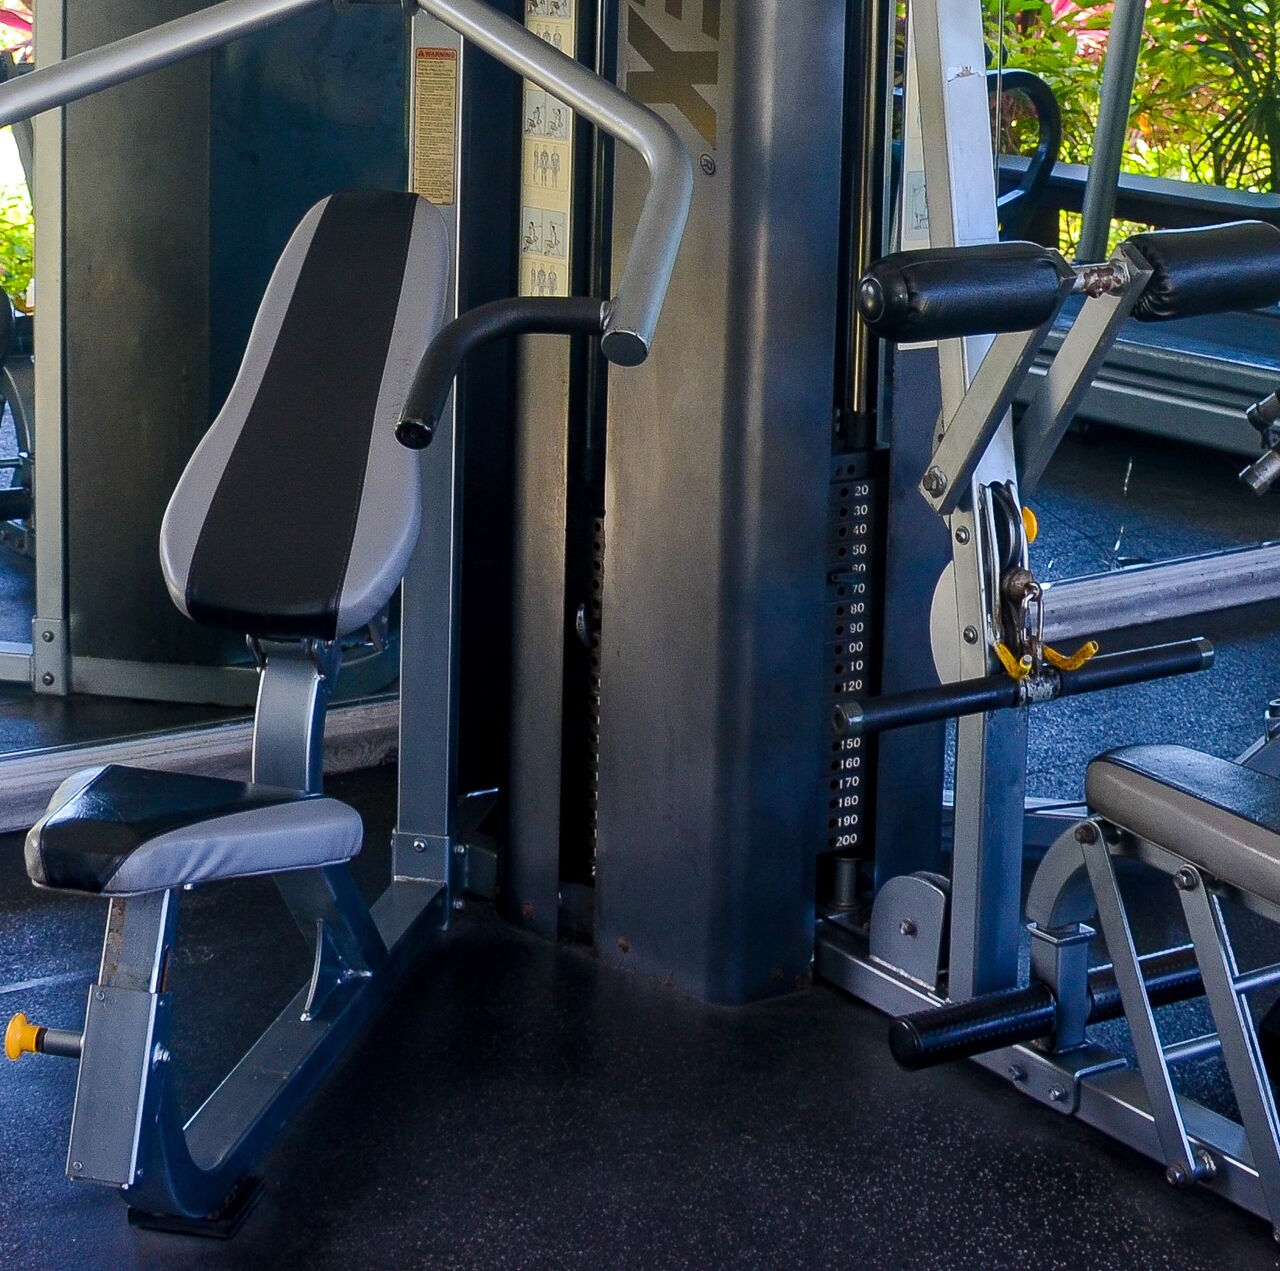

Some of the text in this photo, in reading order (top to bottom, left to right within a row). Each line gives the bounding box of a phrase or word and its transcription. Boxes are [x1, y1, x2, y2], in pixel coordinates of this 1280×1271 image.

[855, 485, 869, 496] 20
[854, 505, 868, 516] 30
[854, 524, 867, 535] 40
[852, 544, 867, 555] 50
[852, 583, 865, 594] 70
[850, 603, 865, 614] 80
[849, 622, 864, 633] 90
[843, 680, 862, 692] 120
[841, 737, 861, 750] 150
[840, 757, 861, 770] 160
[839, 776, 860, 789] 170
[839, 795, 859, 808] 180
[838, 814, 858, 827] 190
[836, 833, 858, 847] 200
